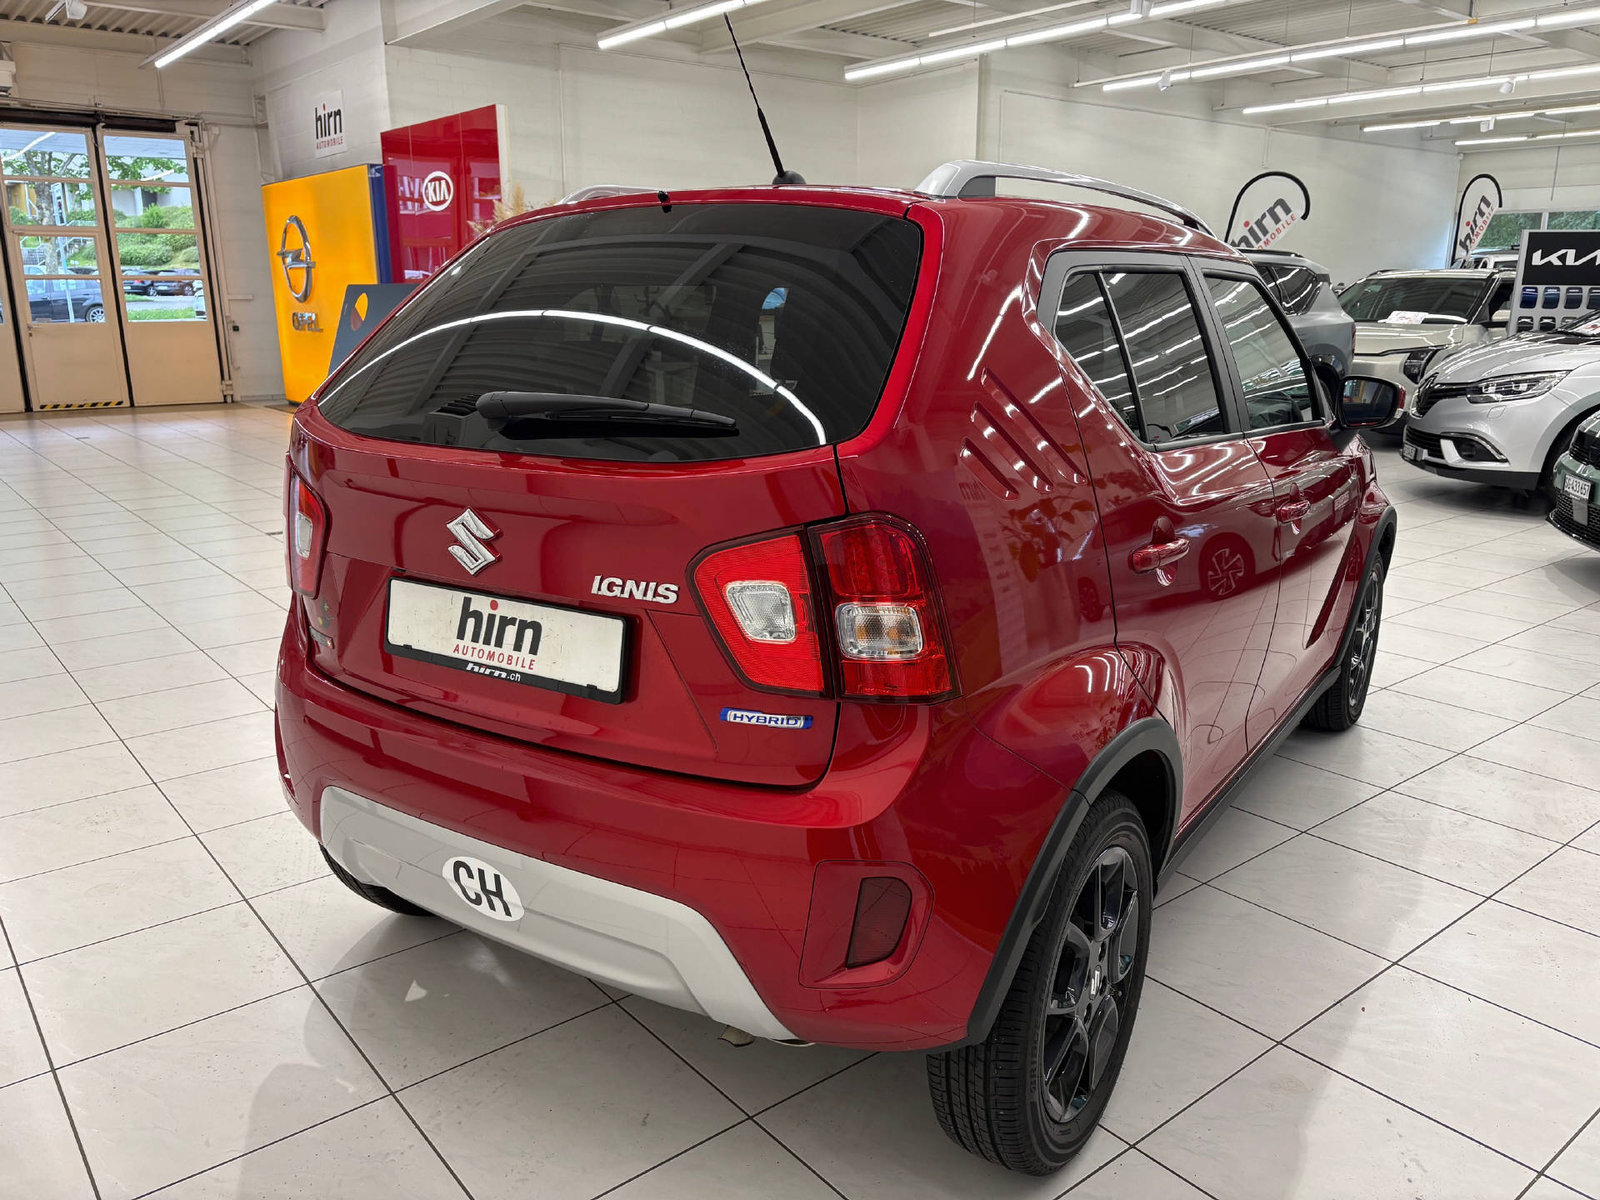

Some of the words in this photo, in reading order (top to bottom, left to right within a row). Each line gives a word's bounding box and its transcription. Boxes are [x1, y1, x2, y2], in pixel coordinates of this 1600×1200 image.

[314, 103, 343, 140] hirn
[427, 179, 449, 202] KIA
[1257, 213, 1297, 250] OMOBILE
[292, 312, 323, 333] OPEL
[591, 575, 679, 604] IGNIS
[456, 596, 543, 656] hirn
[453, 643, 536, 671] AUTOMOBILE
[466, 662, 521, 682] hirn.ch
[732, 713, 800, 726] HYBRID
[453, 860, 512, 918] CH
